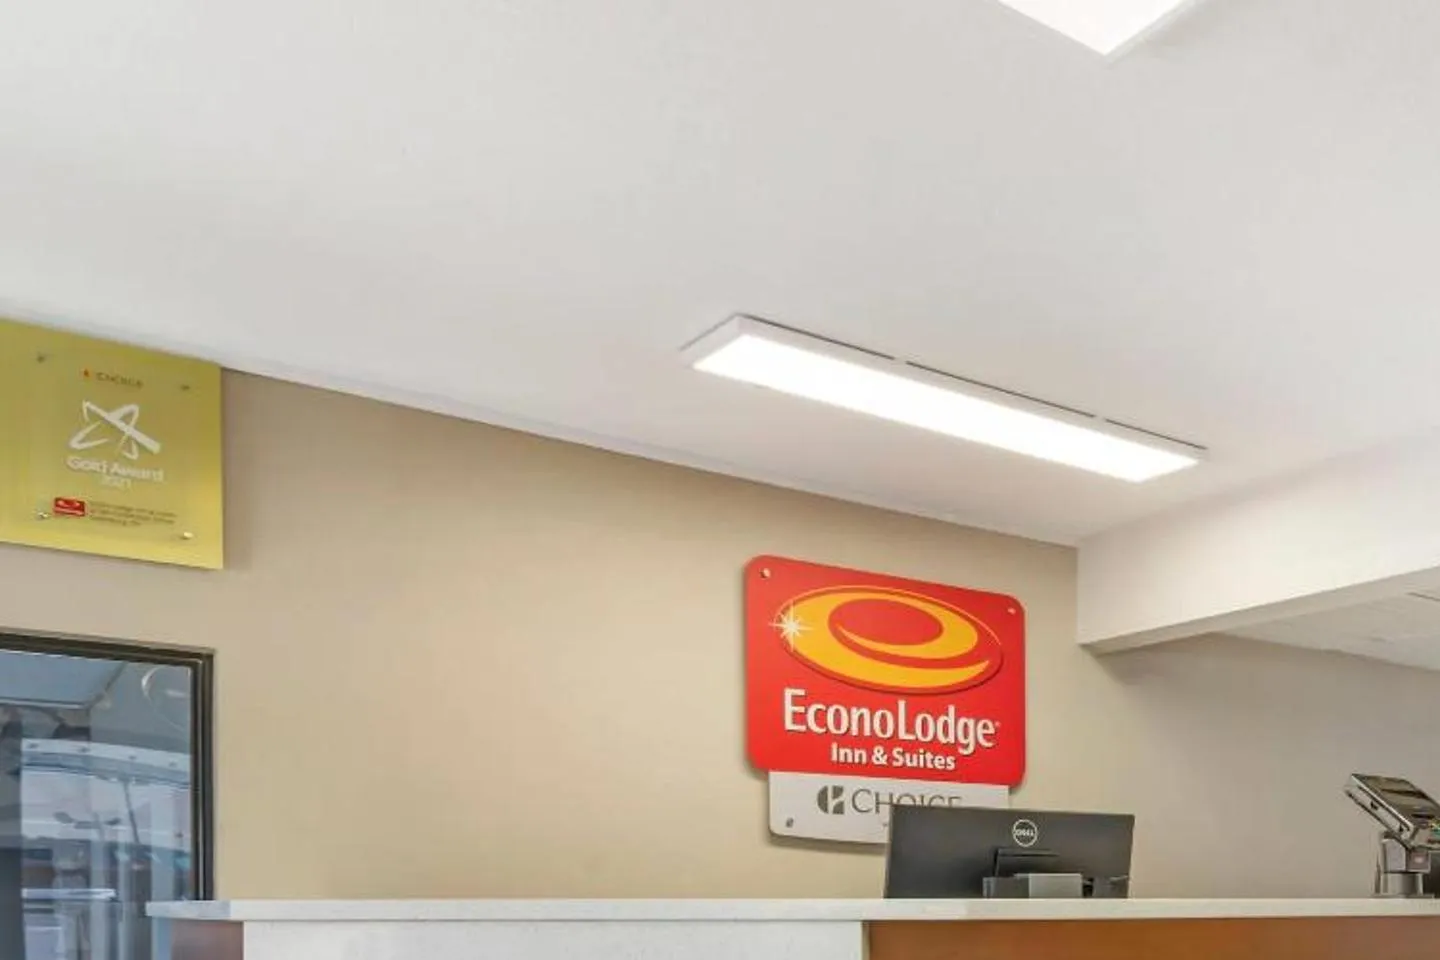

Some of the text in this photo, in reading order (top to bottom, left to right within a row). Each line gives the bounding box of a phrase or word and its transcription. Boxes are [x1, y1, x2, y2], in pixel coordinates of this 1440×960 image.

[783, 687, 996, 755] EconoLodge
[831, 742, 956, 770] Inn & Suites
